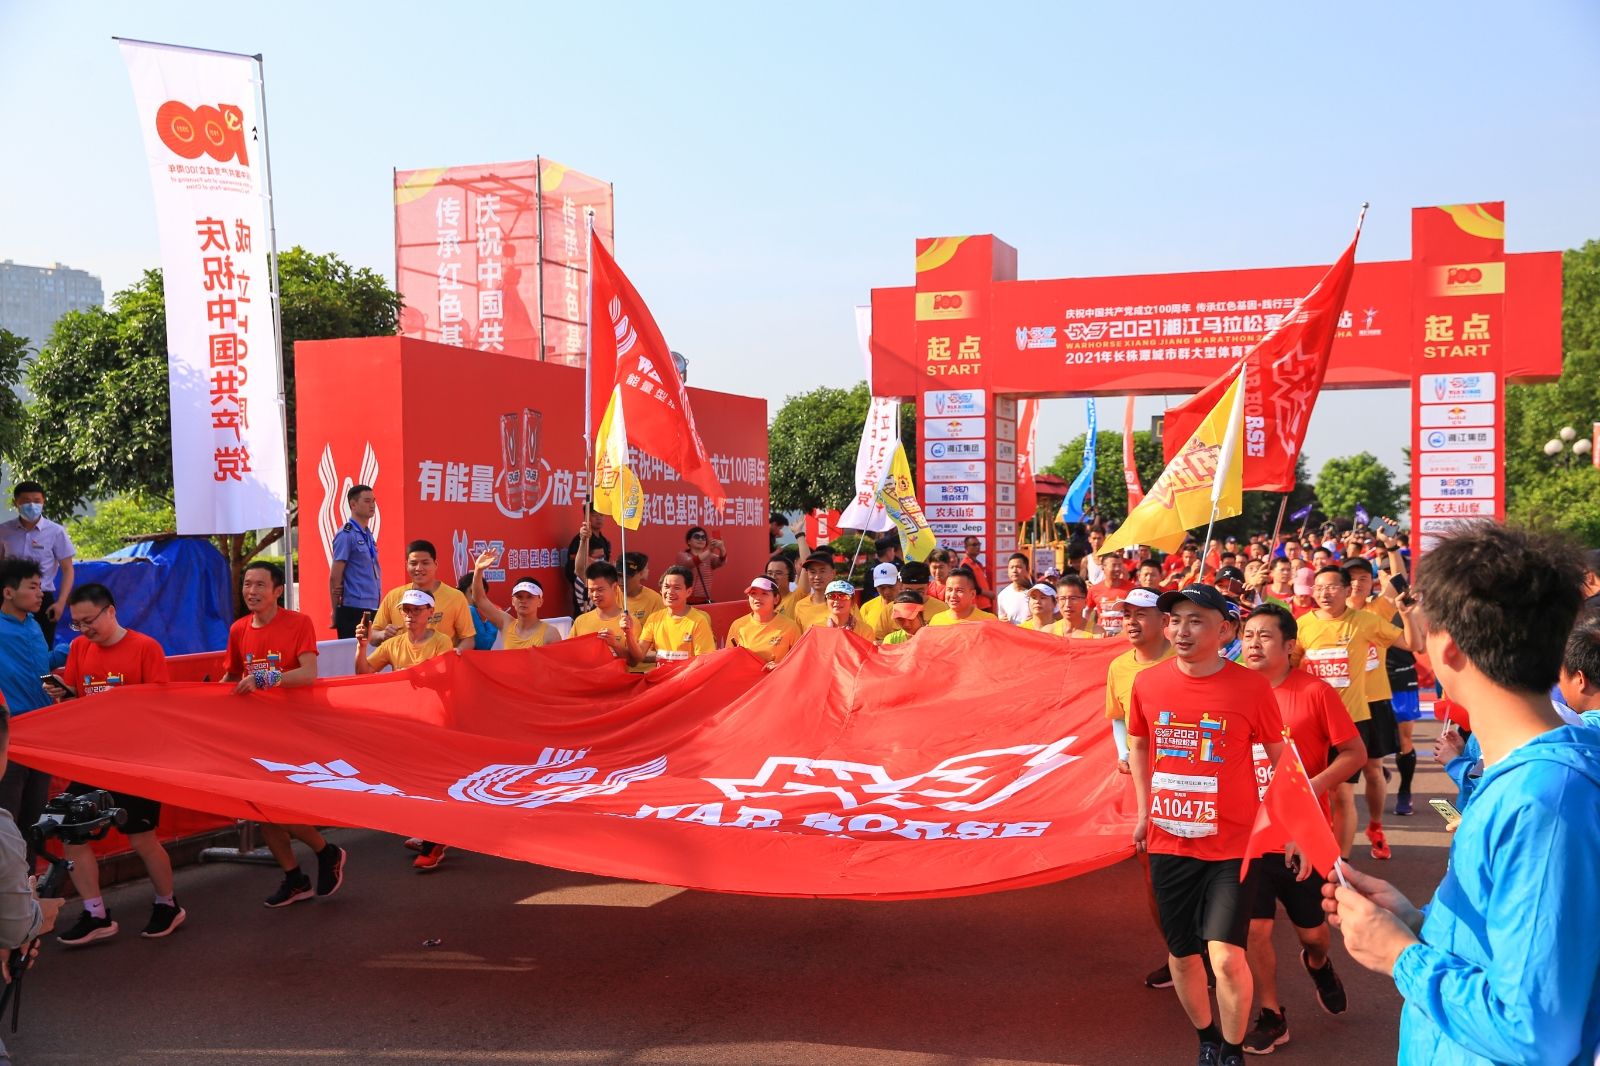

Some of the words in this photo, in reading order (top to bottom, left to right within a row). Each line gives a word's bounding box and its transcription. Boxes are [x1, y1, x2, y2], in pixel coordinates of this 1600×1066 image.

[1065, 304, 1191, 320] 庆祝中国共产党成立100周年
[1424, 313, 1491, 342] 起点
[927, 336, 982, 361] 起点
[1066, 341, 1122, 350] WARHORSE
[1125, 339, 1156, 347] XIANG
[1160, 338, 1190, 346] JIANG
[1194, 335, 1255, 345] MARATHON
[1423, 344, 1492, 359] START
[926, 363, 982, 377] START
[625, 372, 676, 411] 能量型
[1245, 391, 1265, 457] HORSE
[418, 460, 494, 503] 有能量
[936, 508, 974, 518] 农夫山泉
[962, 524, 983, 533] Jeep
[508, 548, 568, 569] 能量型维生
[1306, 663, 1348, 678] A13952
[1151, 795, 1216, 820] A10475
[800, 812, 1054, 840] HORSE
